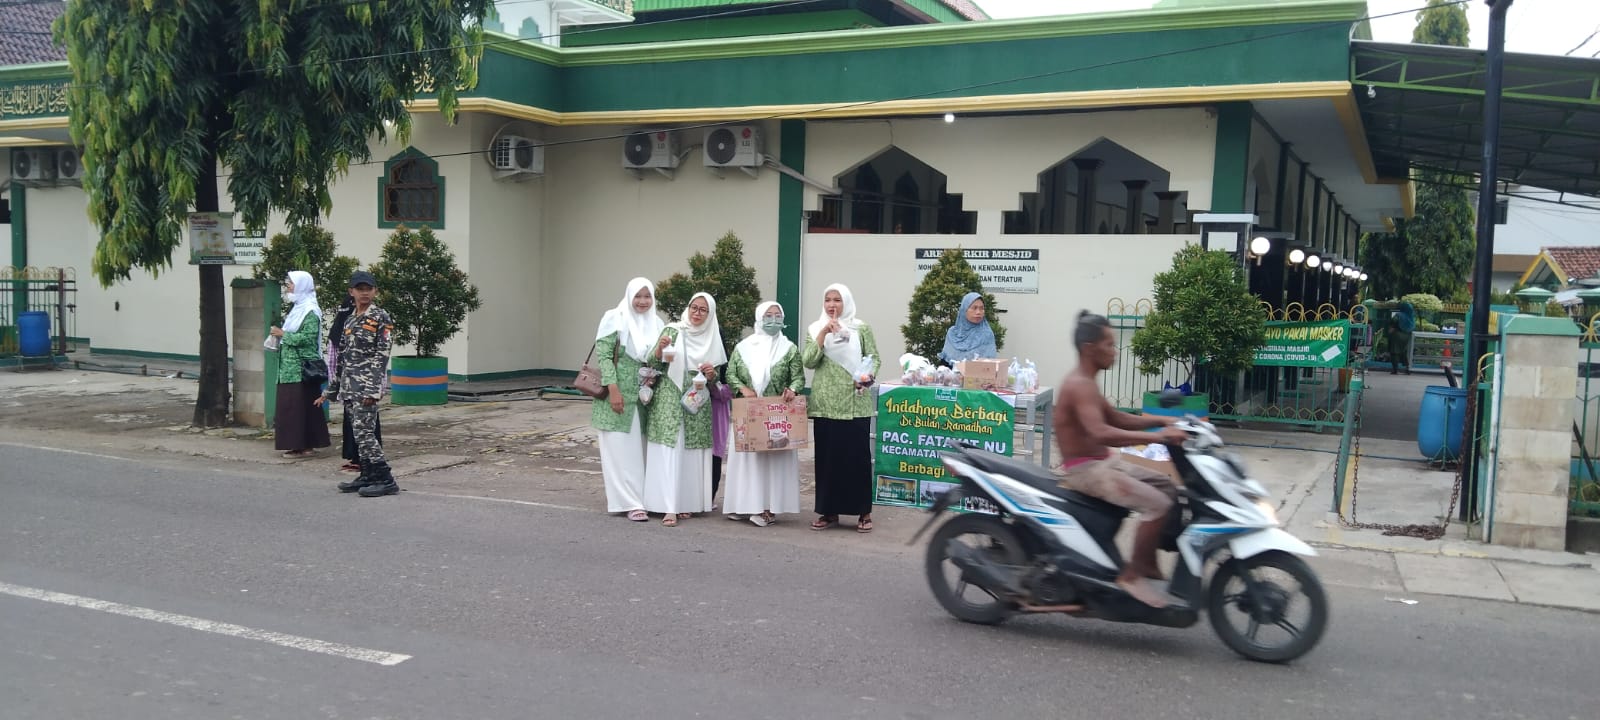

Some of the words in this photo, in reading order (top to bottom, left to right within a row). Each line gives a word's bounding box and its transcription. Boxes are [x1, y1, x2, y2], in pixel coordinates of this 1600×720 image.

[922, 250, 944, 258] ARE
[991, 250, 1032, 259] MESJID
[978, 264, 1017, 272] KENDARAAN
[1018, 264, 1036, 272] ANDA
[994, 275, 1023, 283] TERATUR
[1264, 327, 1281, 340] AYO
[1283, 326, 1308, 340] PAKAI
[1309, 326, 1344, 341] MASKER
[885, 397, 947, 419] Indahnya
[764, 421, 792, 433] Tango
[913, 415, 940, 430] Bulan
[942, 419, 993, 435] Ramadhan
[882, 431, 913, 445] PAC.
[984, 440, 1006, 454] NU
[899, 461, 945, 478] Berbagi
